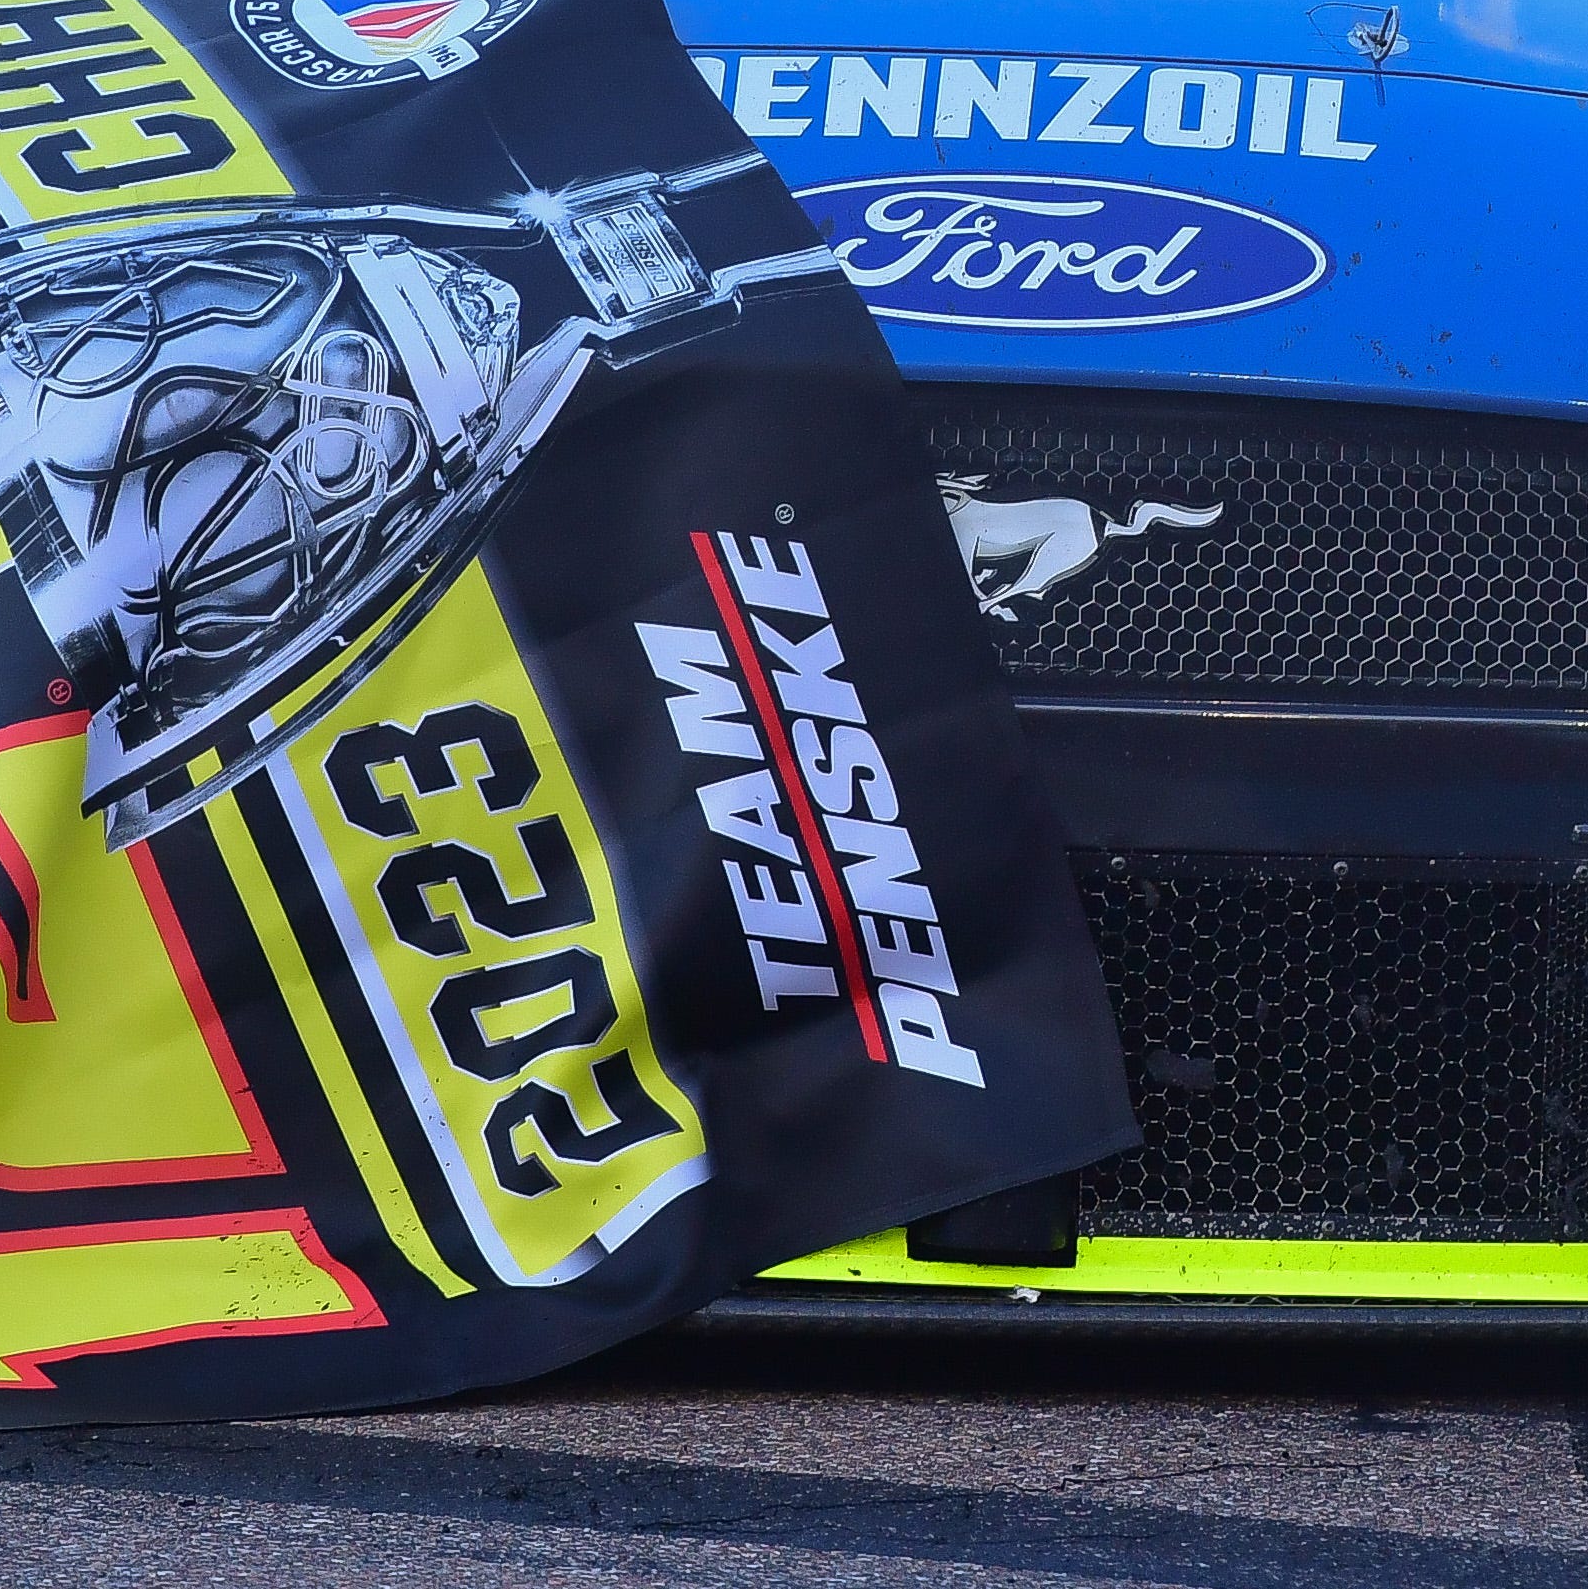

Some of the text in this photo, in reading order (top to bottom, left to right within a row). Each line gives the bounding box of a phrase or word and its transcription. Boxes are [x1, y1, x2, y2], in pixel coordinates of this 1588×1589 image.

[258, 27, 385, 83] NASCAR
[832, 191, 1202, 296] Ford
[321, 699, 682, 1198] 2023
[633, 620, 841, 1014] TEAM
[715, 534, 987, 1090] PENSKE
